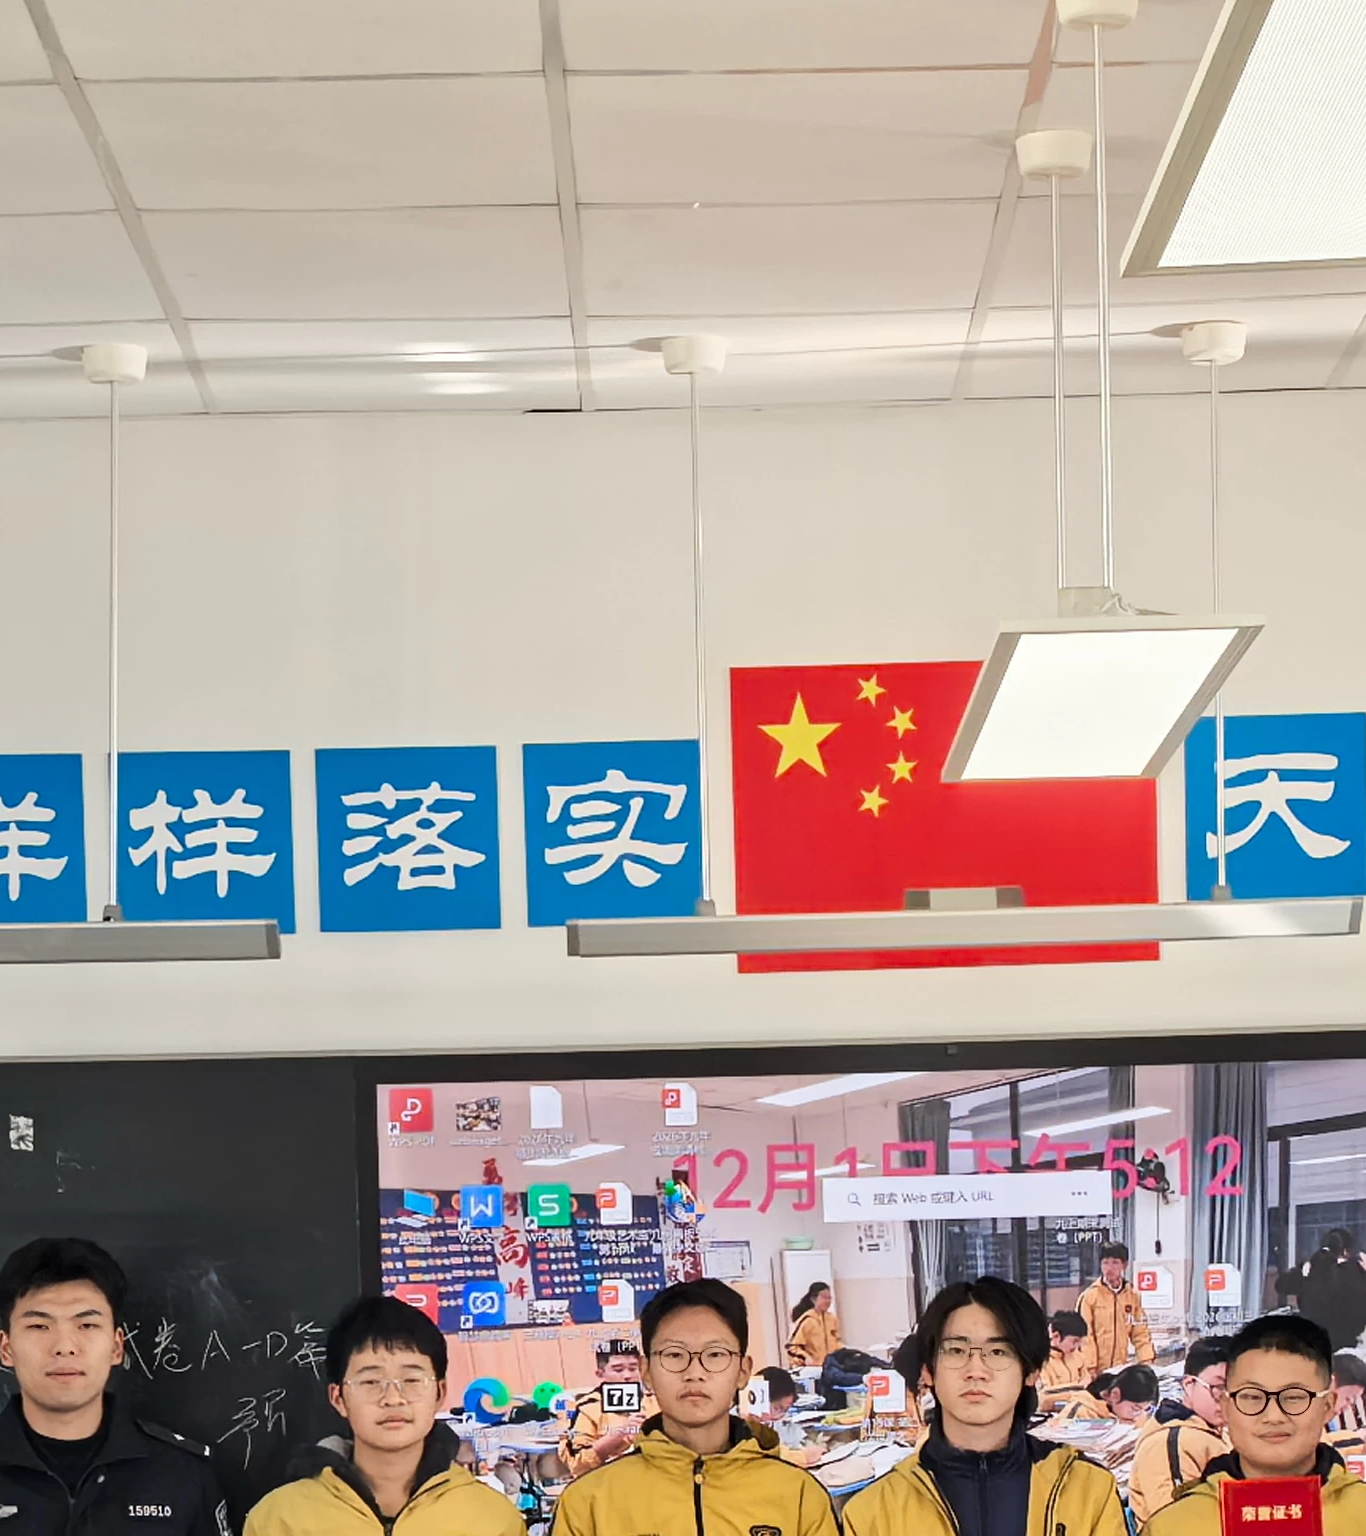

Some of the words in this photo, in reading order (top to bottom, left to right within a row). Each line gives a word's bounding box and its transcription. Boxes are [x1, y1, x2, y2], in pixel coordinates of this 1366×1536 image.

[971, 1190, 994, 1202] URL
[1241, 1503, 1303, 1522] 荣誉证书
